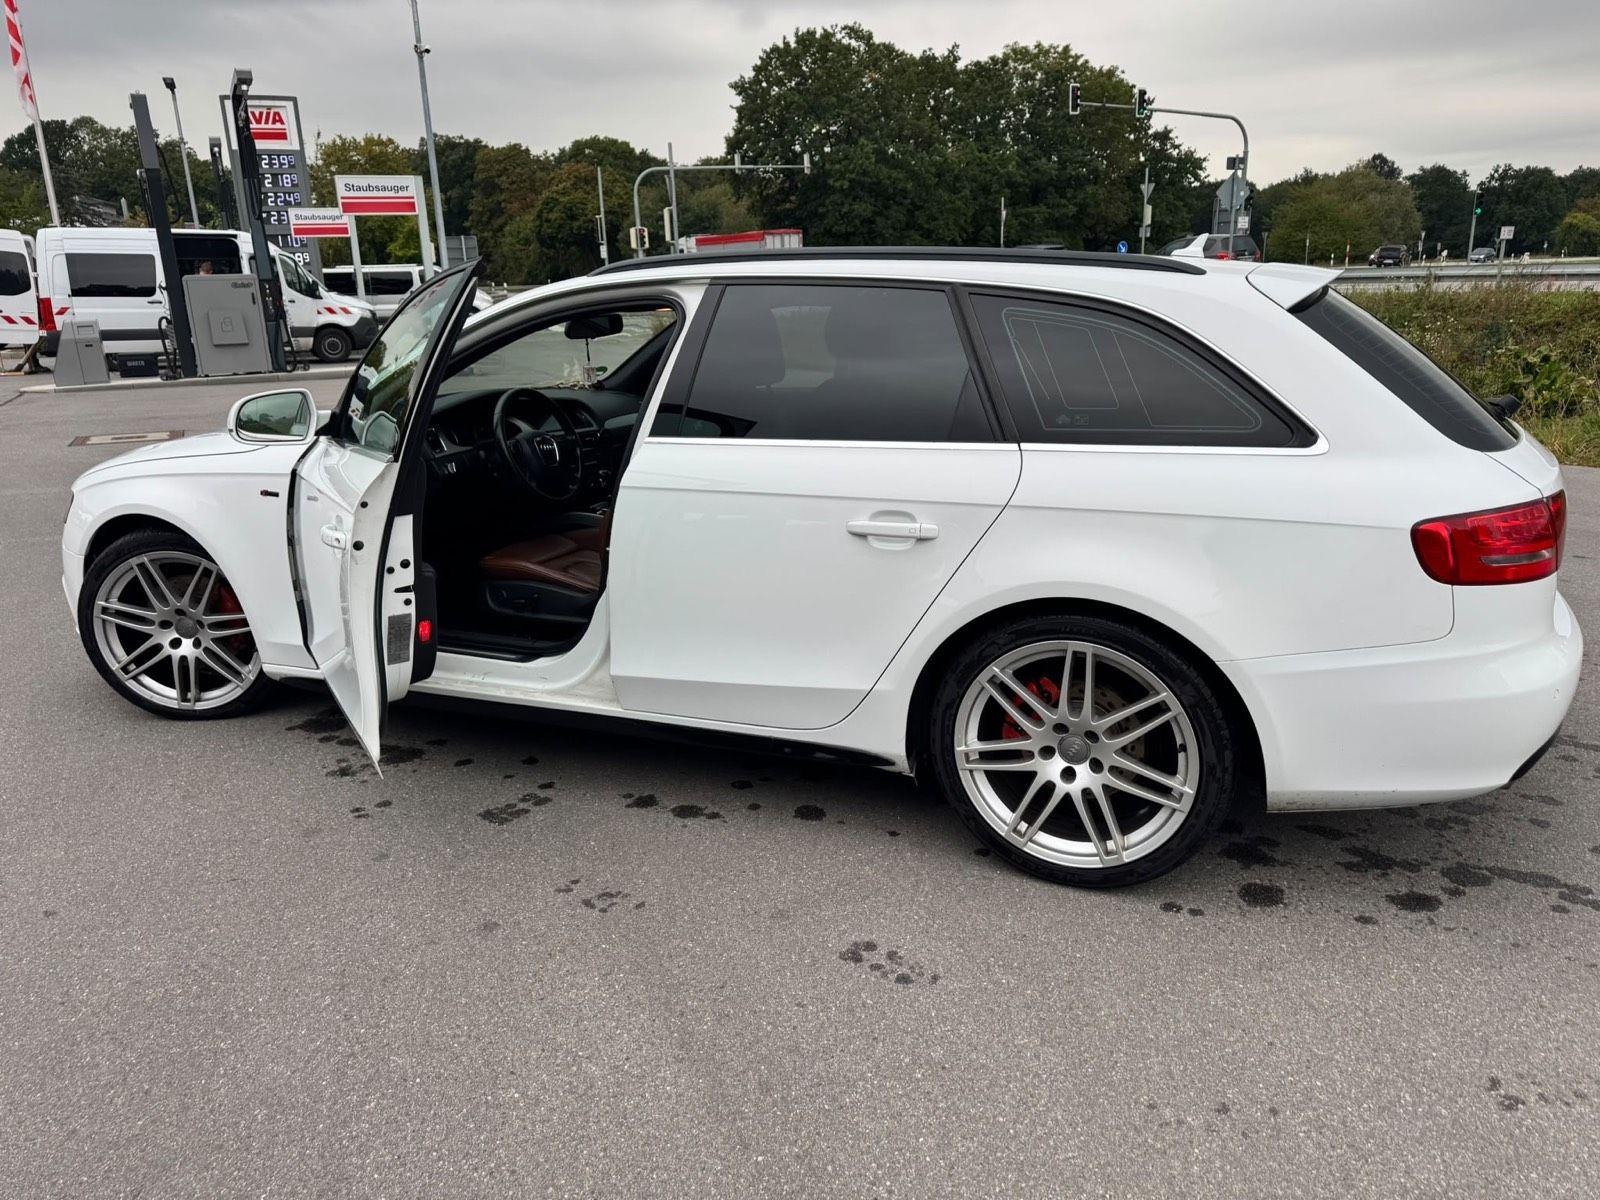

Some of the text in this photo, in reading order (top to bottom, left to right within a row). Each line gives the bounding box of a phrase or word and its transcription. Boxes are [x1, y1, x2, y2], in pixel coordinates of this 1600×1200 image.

[250, 108, 285, 125] VIA
[261, 155, 295, 169] 2399
[344, 182, 410, 194] Staubsauger
[267, 192, 301, 206] 2249
[294, 213, 343, 222] Staubsauger
